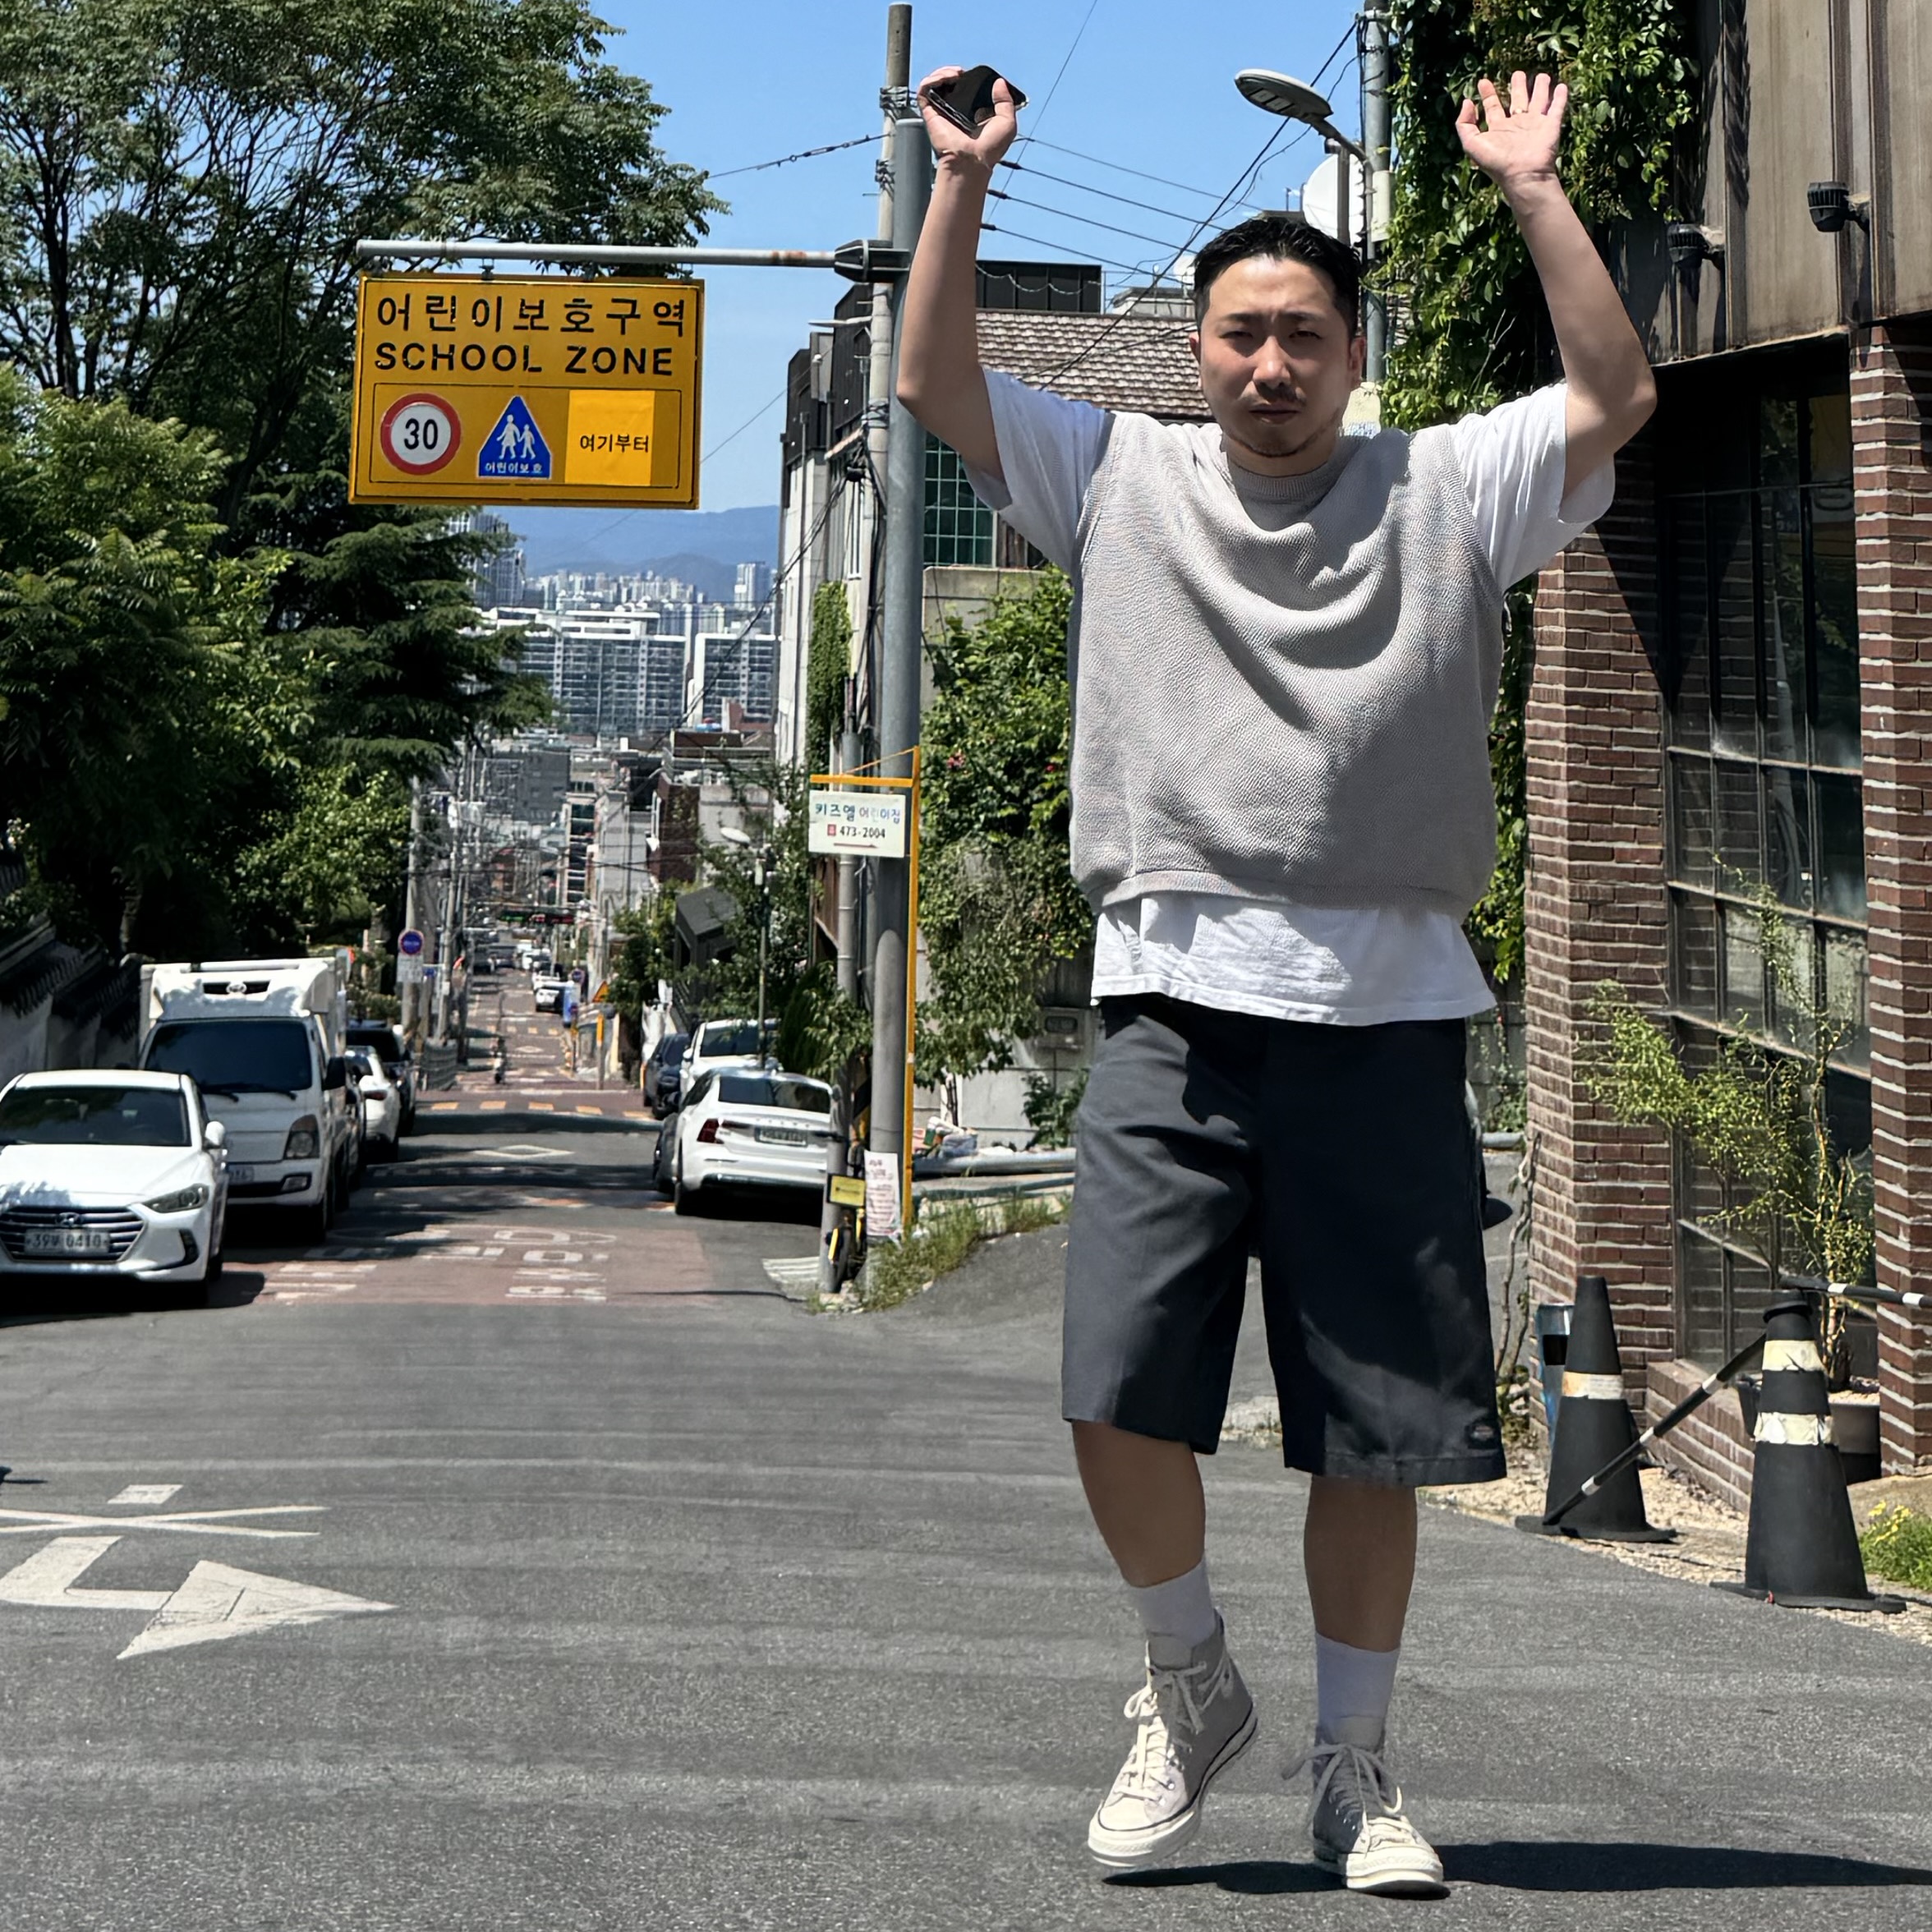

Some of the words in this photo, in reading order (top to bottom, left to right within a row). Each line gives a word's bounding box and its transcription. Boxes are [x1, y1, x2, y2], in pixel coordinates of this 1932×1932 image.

[378, 293, 684, 337] 어린이보호구역
[375, 342, 542, 372] SCHOOL
[565, 346, 673, 376] ZONE
[404, 419, 438, 449] 30
[580, 435, 649, 453] 여기부터
[485, 462, 543, 474] 어린이보호
